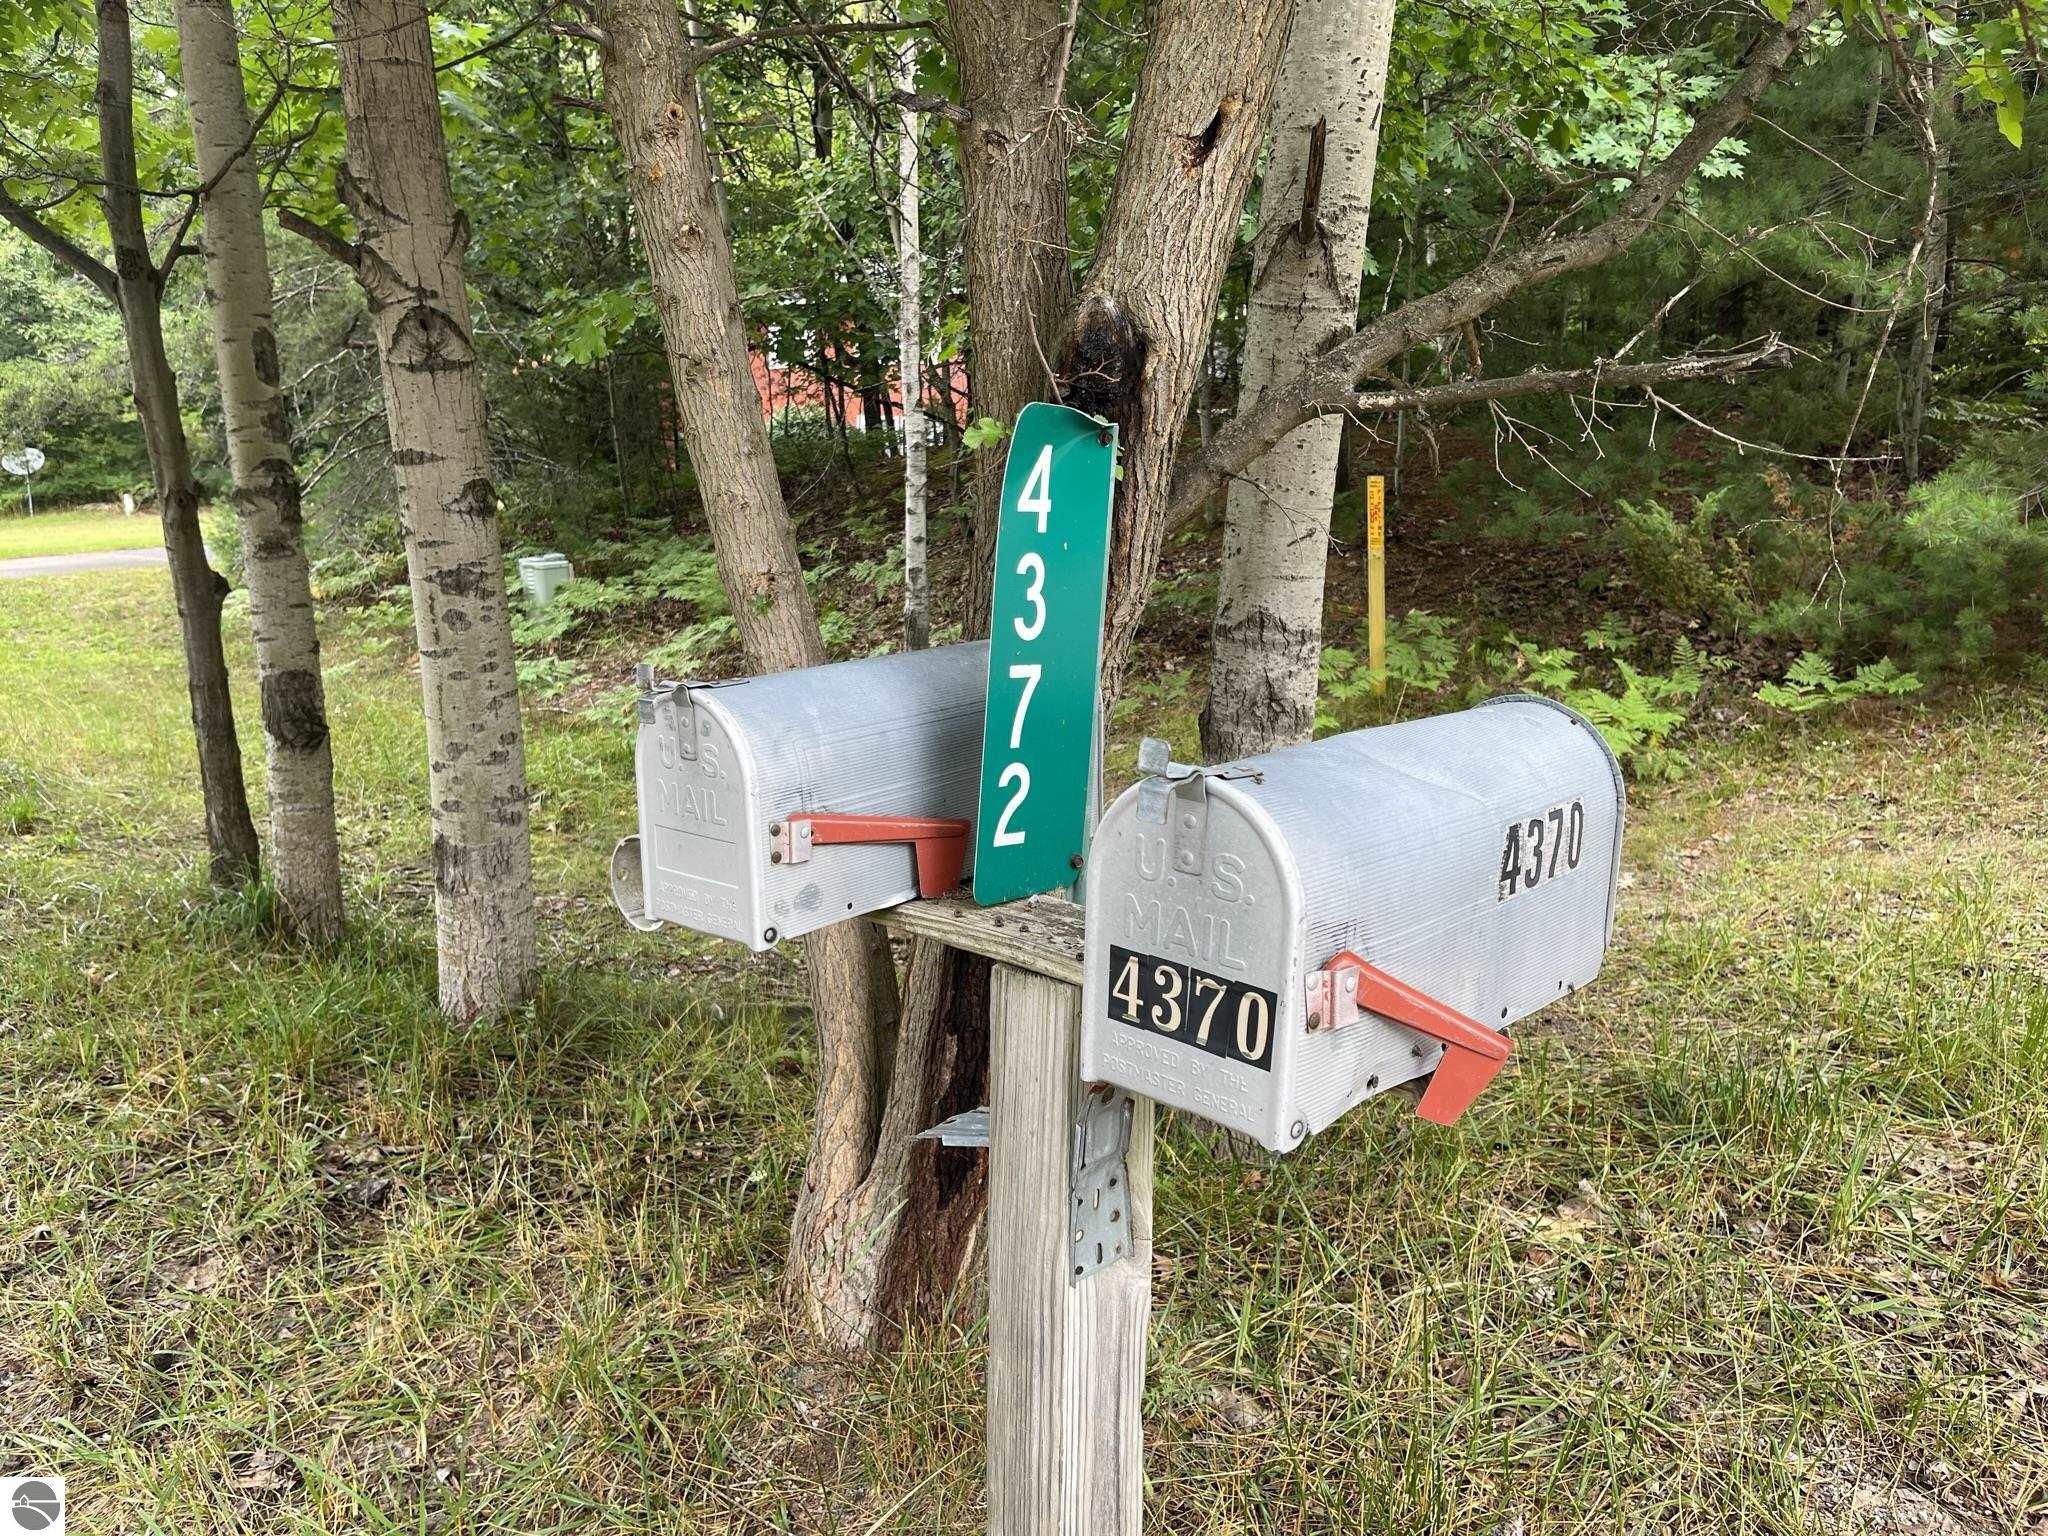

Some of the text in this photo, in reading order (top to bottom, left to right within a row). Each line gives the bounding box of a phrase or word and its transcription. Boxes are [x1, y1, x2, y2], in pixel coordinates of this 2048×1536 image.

[993, 444, 1053, 848] 4372
[656, 778, 728, 826] MAIL
[1500, 801, 1585, 897] 4370
[1123, 891, 1248, 971] MAIL
[1111, 955, 1269, 1061] 4370
[1102, 1052, 1256, 1123] POSTMASTER GENERAL
[1111, 1031, 1250, 1093] APPROVED BY THE
